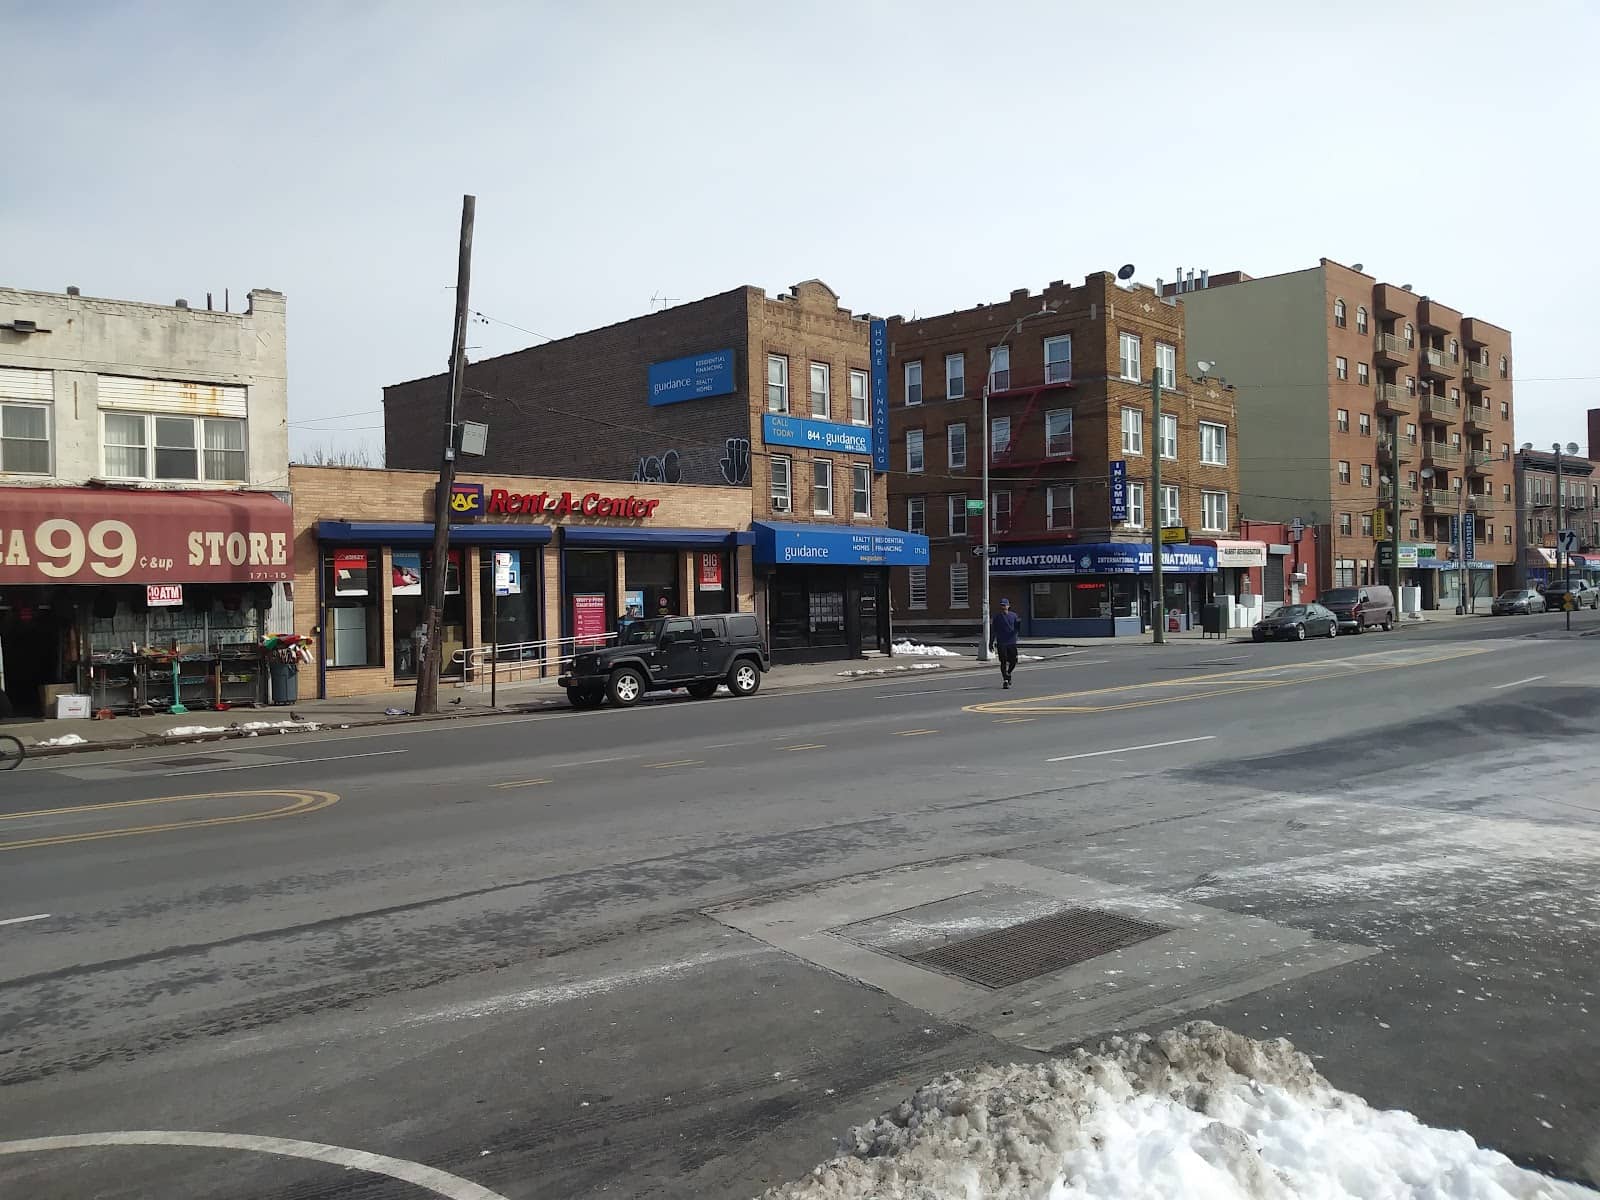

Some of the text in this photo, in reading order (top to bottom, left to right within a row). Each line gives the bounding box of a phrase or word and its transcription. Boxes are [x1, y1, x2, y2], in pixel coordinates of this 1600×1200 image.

[695, 356, 726, 367] RESIDENTIAL
[695, 364, 724, 374] FINANCING
[654, 378, 692, 396] guidance
[696, 378, 714, 387] REALTY
[771, 416, 789, 427] CALL
[773, 428, 795, 439] TODAY
[807, 430, 821, 442] 844
[826, 432, 866, 447] guidance
[1111, 505, 1126, 513] TAX
[875, 537, 904, 545] RESIDENTIAL
[34, 518, 138, 578] 99
[187, 531, 288, 566] STORE
[785, 544, 829, 561] guidance
[853, 544, 871, 552] HOMES
[875, 545, 903, 553] FINANCING
[703, 553, 718, 567] BIG
[249, 572, 288, 580] 171-15
[160, 586, 180, 600] ATM
